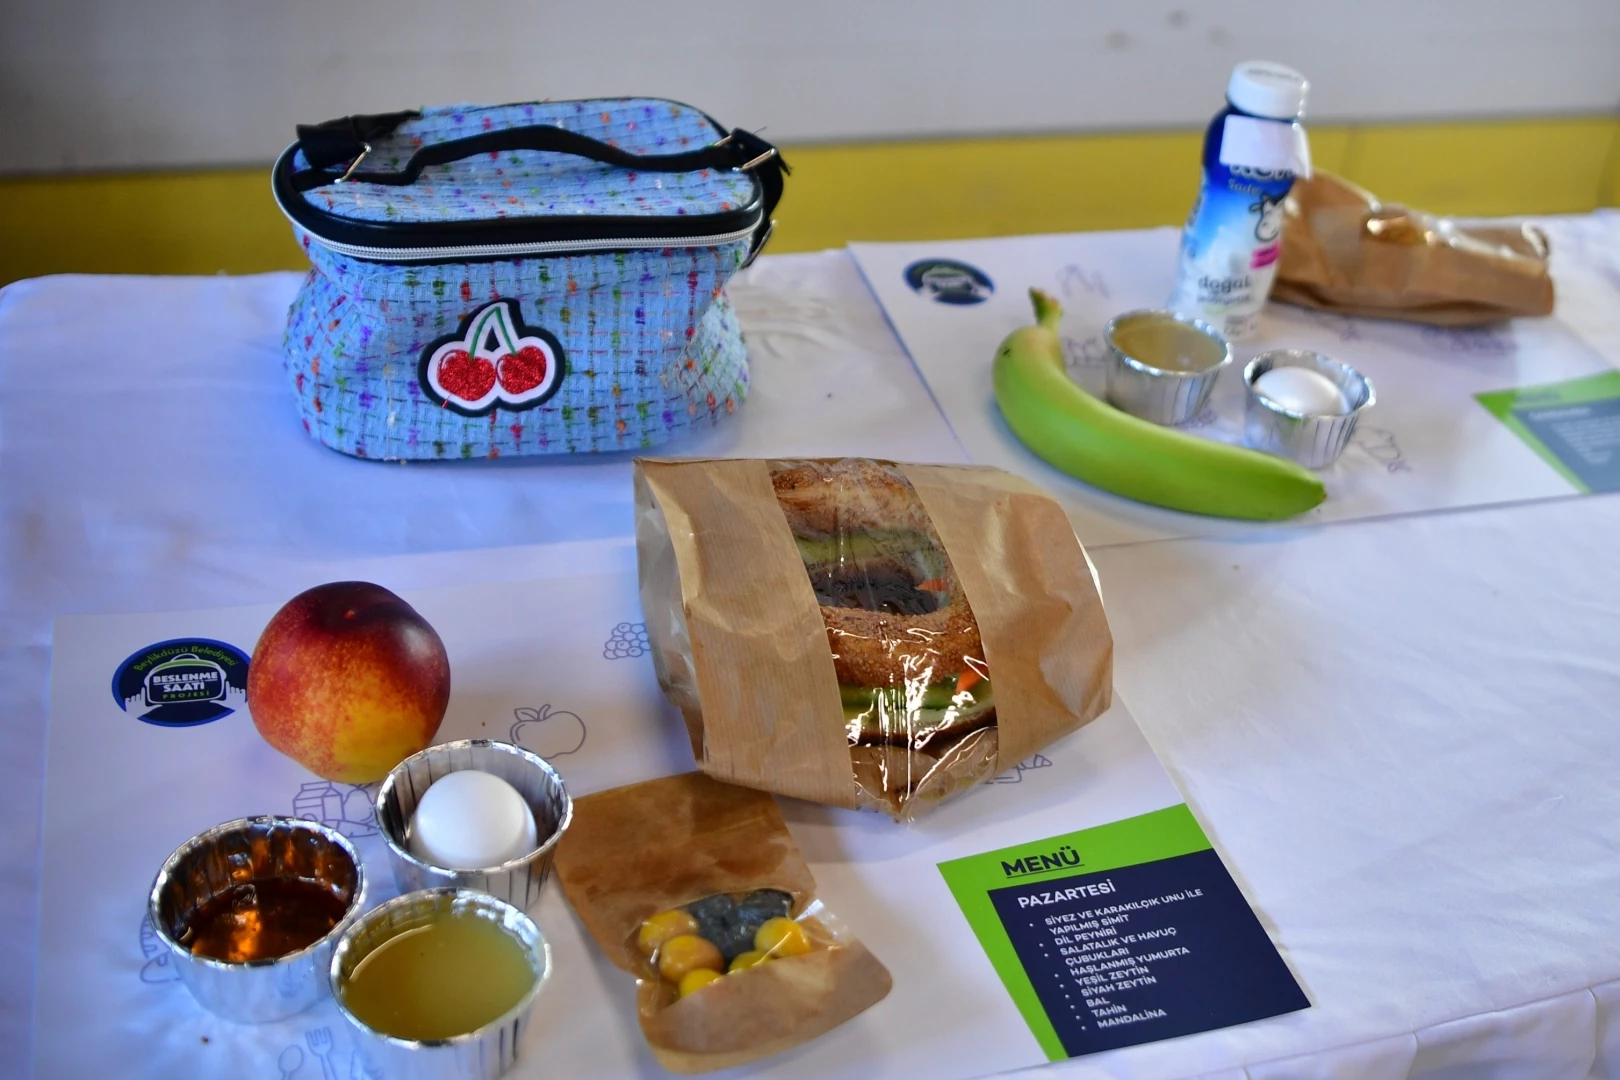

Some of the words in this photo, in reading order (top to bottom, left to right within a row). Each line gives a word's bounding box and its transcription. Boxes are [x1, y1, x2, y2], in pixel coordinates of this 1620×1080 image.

[133, 647, 188, 671] Beylikdüzü
[191, 646, 237, 667] Belediyesi
[153, 672, 218, 683] BESLENME
[163, 681, 205, 693] SAATİ
[162, 690, 210, 700] PROJESİ
[1001, 846, 1081, 876] MENÜ
[1018, 879, 1116, 908] PAZARTESİ
[1044, 914, 1077, 926] SİYEZ
[1077, 910, 1094, 920] VE
[1094, 898, 1160, 917] KARAKILÇIK
[1161, 892, 1185, 904] UNU
[1185, 888, 1203, 898] İLE
[1049, 920, 1100, 936] YAPILMIŞ
[1101, 914, 1129, 926] SİMİT
[1054, 935, 1073, 946] DİL
[1074, 926, 1118, 943] PEYNİRİ
[1060, 938, 1120, 955] SALATALIK
[1120, 935, 1137, 944] VE
[1137, 927, 1177, 941] HAVUÇ
[1065, 947, 1130, 967] ÇUBUKLARI
[1070, 957, 1136, 977] HAŞLANMIŞ
[1136, 947, 1190, 963] YUMURTA
[1075, 973, 1108, 986] YEŞİL
[1108, 965, 1150, 981] ZEYTİN
[1081, 984, 1115, 997] SİYAH
[1115, 975, 1157, 991] ZEYTİN
[1086, 997, 1110, 1008] BAL
[1091, 1004, 1128, 1018] TAHİN
[1097, 1008, 1168, 1029] MANDALİNA
